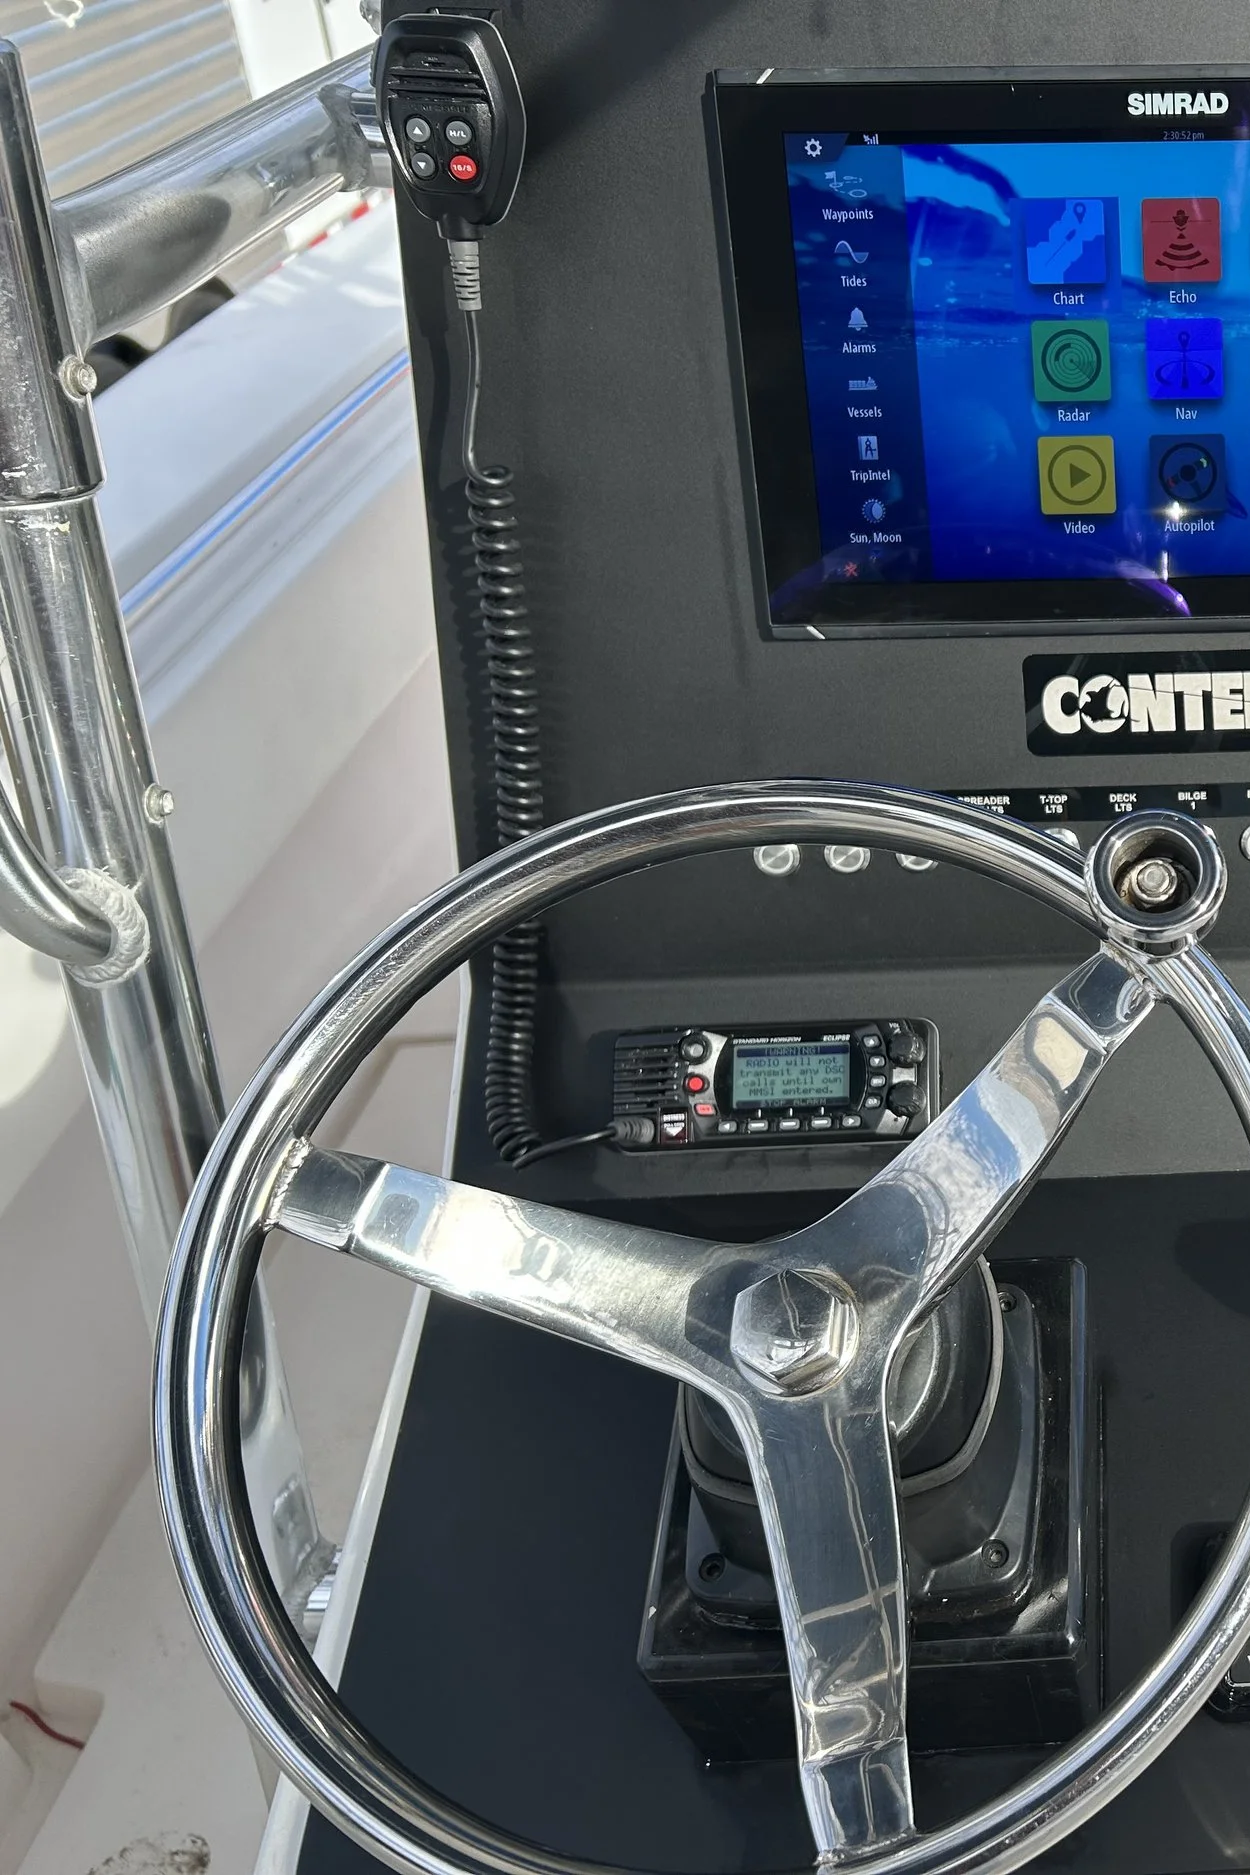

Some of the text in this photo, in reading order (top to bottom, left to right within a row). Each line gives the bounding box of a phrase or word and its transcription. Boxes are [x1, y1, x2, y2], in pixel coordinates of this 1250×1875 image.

[1128, 93, 1229, 116] SIMRAD
[449, 130, 467, 138] H/L
[1163, 130, 1205, 141] 2:30:52 pm
[822, 207, 874, 222] Waypoints
[840, 275, 867, 288] Tides
[1053, 292, 1085, 306] Chart
[1169, 290, 1197, 304] Echo
[842, 341, 877, 355] Alarms
[847, 406, 882, 419] Vessels
[1057, 409, 1091, 422] Radar
[1175, 407, 1198, 420] Nav
[850, 469, 891, 483] TripIntel
[1063, 521, 1096, 534] Video
[1164, 518, 1216, 534] Autopilot
[850, 532, 902, 545] Sun, Moon
[1039, 794, 1068, 804] T-TOP
[1109, 793, 1137, 803] DECK
[1178, 791, 1207, 801] BILGE
[1045, 804, 1063, 814] LTS
[1115, 802, 1133, 812] LTS
[1191, 801, 1196, 810] 1
[823, 1033, 851, 1042] ECLIPSE
[746, 1056, 838, 1068] RADIO will not
[740, 1064, 846, 1078] transmit any DSC
[742, 1076, 842, 1088] calls until own
[749, 1086, 833, 1097] MMSI entered.
